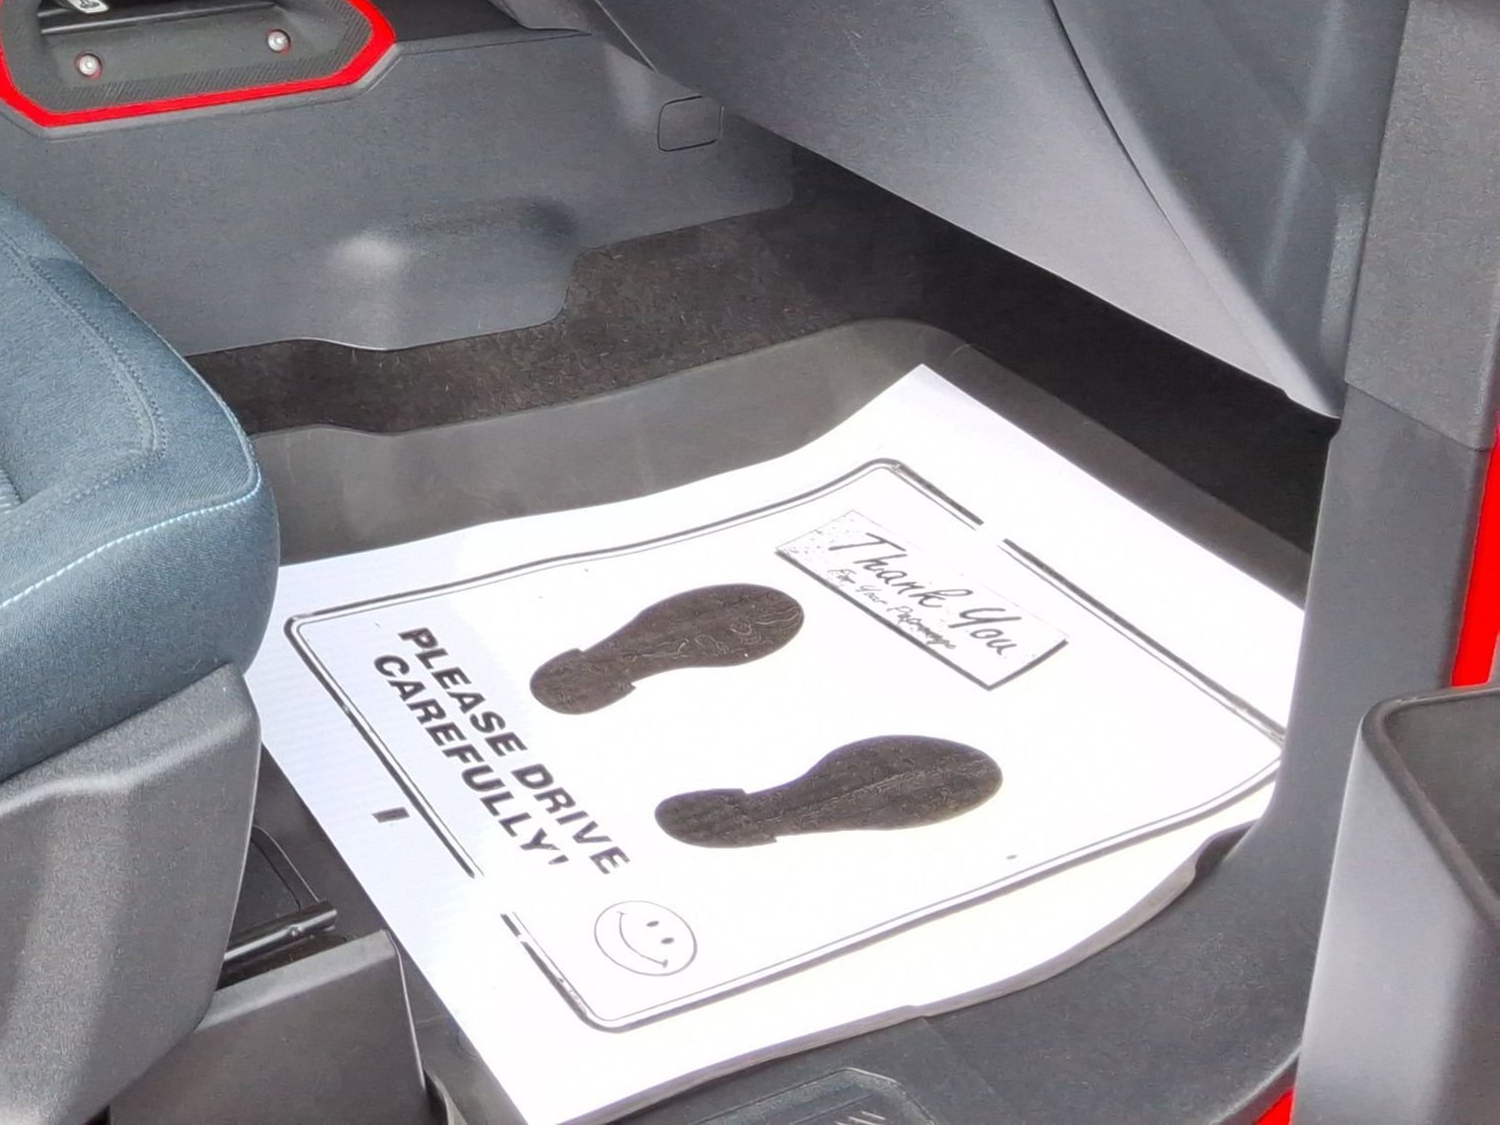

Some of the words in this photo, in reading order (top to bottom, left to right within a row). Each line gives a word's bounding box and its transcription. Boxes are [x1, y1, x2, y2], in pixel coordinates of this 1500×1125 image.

[827, 531, 974, 608] Thank
[947, 607, 1023, 656] You
[855, 585, 889, 606] Your
[397, 626, 528, 757] PLEASE
[510, 763, 631, 875] DRIVE
